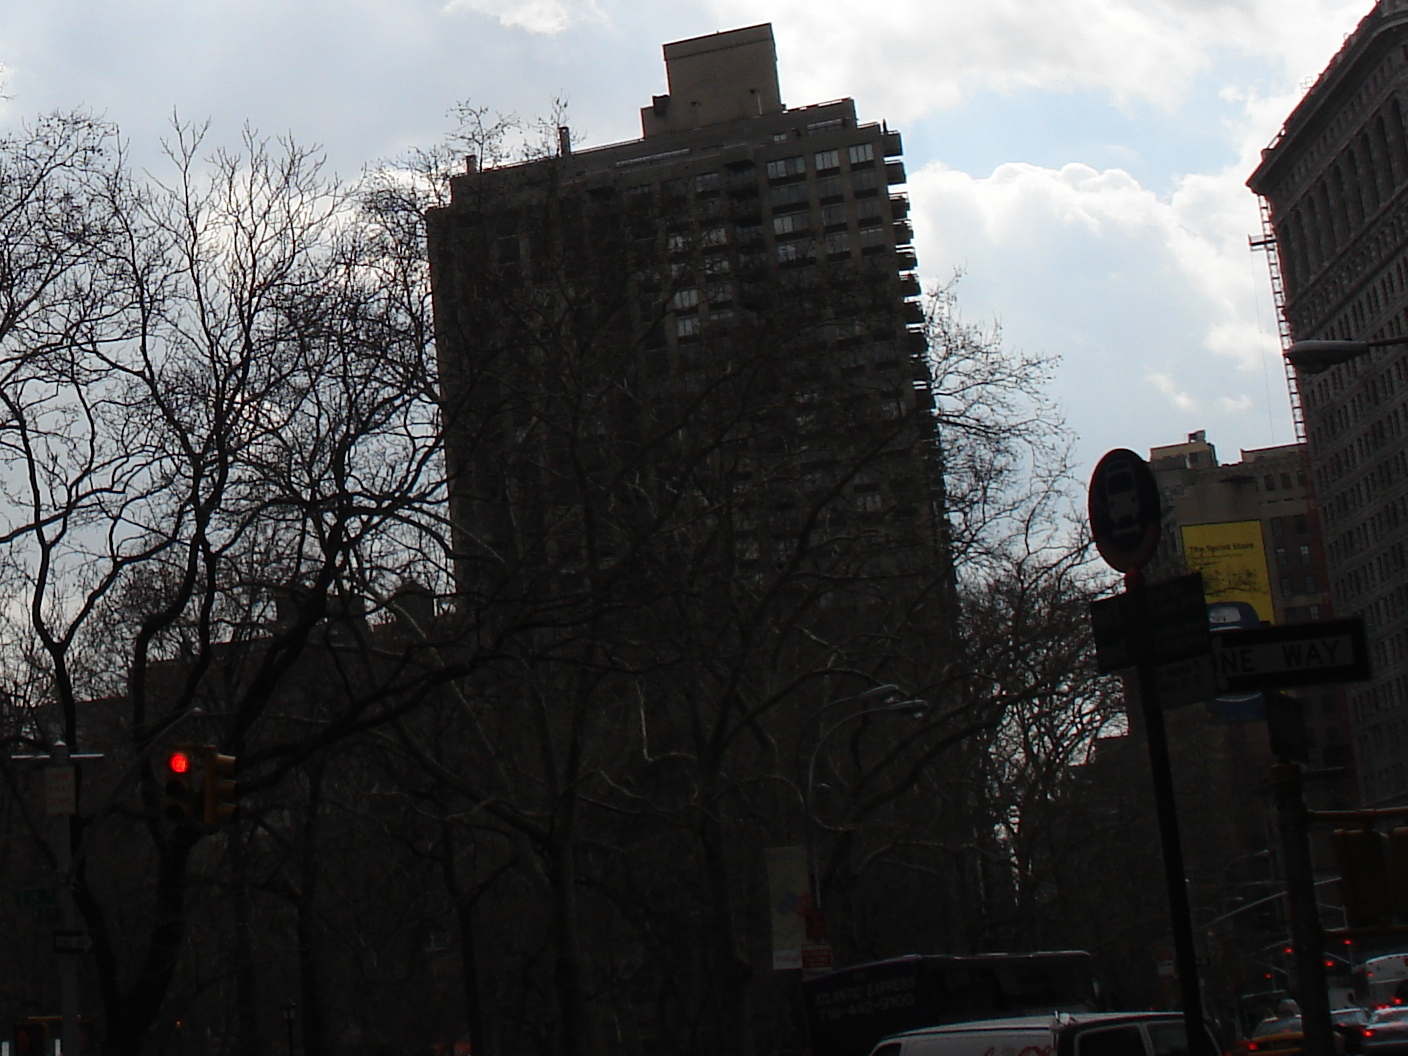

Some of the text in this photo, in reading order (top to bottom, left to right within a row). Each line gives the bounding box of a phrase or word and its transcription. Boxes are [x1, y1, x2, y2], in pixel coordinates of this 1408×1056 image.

[1212, 649, 1257, 675] NE
[1282, 639, 1339, 667] WAY
[815, 986, 864, 1006] ATLANTIC
[866, 975, 916, 997] EXPRESS
